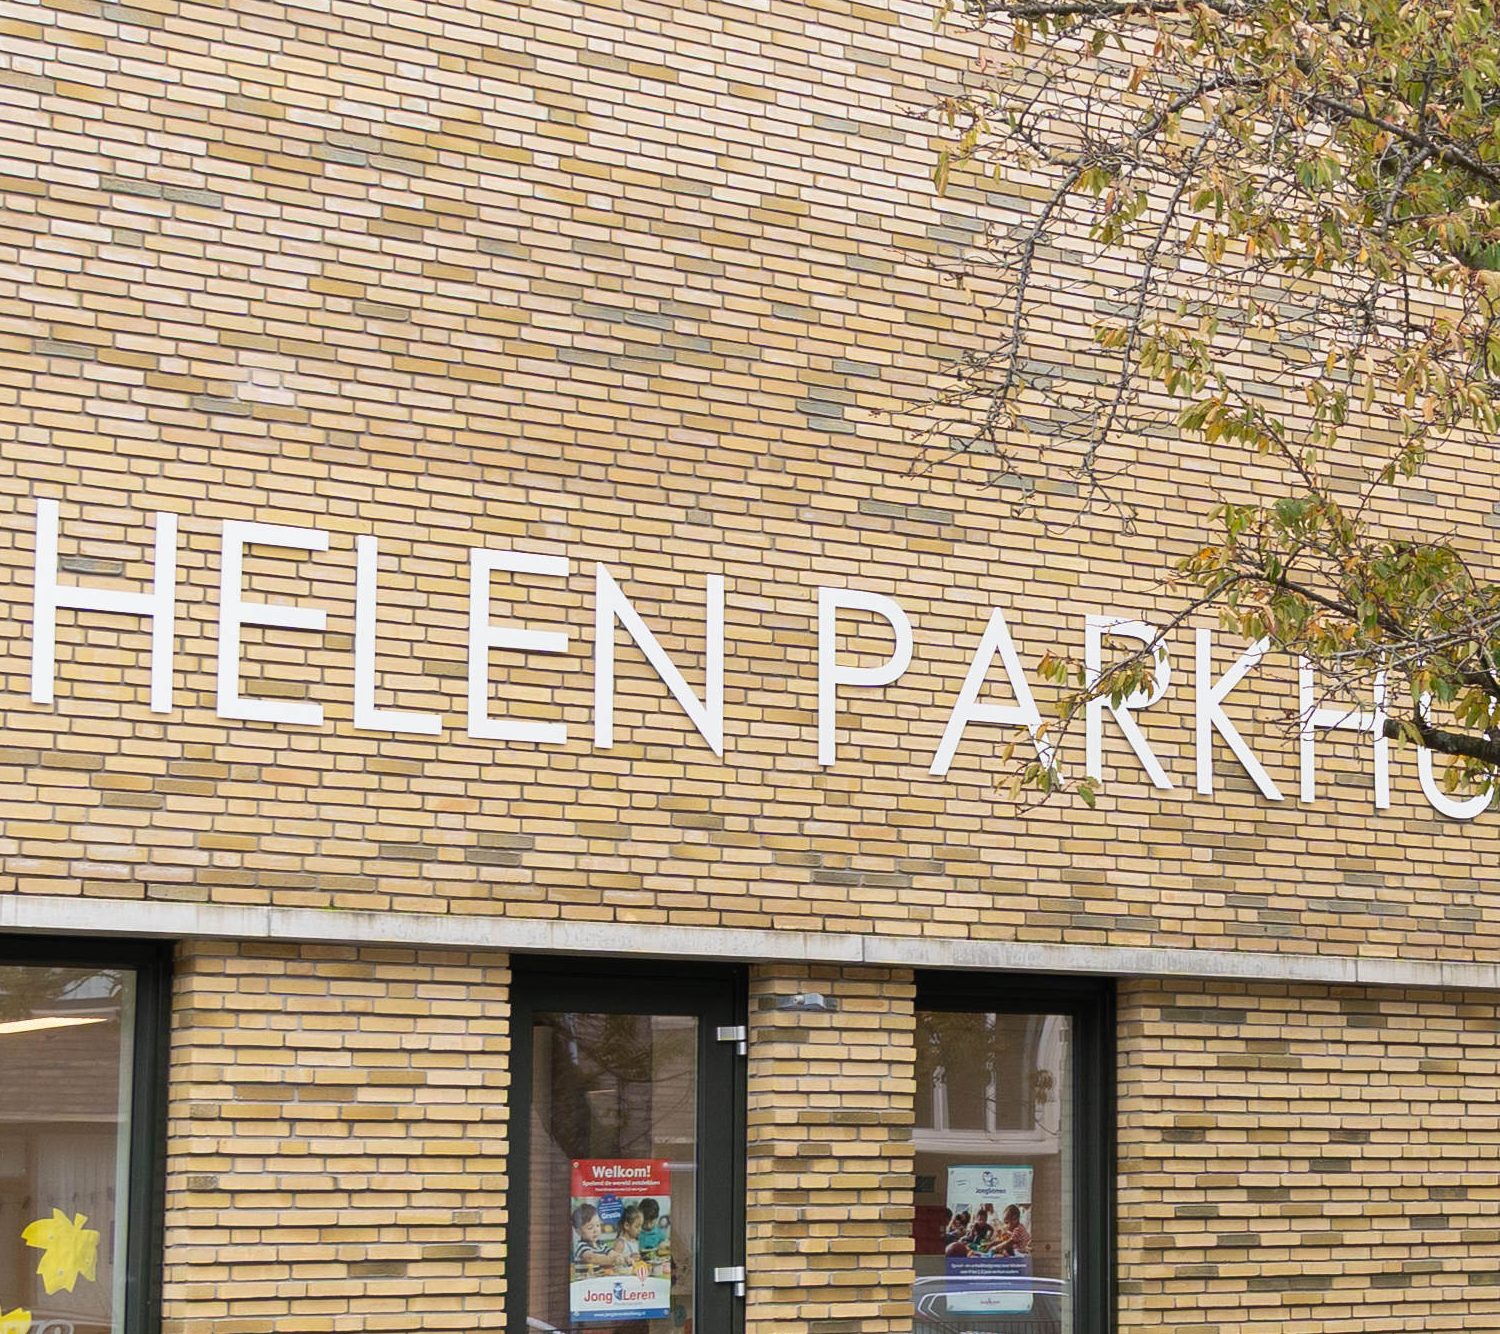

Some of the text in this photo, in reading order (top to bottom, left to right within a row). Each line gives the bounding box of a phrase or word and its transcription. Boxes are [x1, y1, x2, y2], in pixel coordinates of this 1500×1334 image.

[30, 498, 726, 757] HELEN
[591, 1165, 651, 1178] Welkom!
[583, 1290, 612, 1304] Jong
[623, 1290, 655, 1301] Leren
